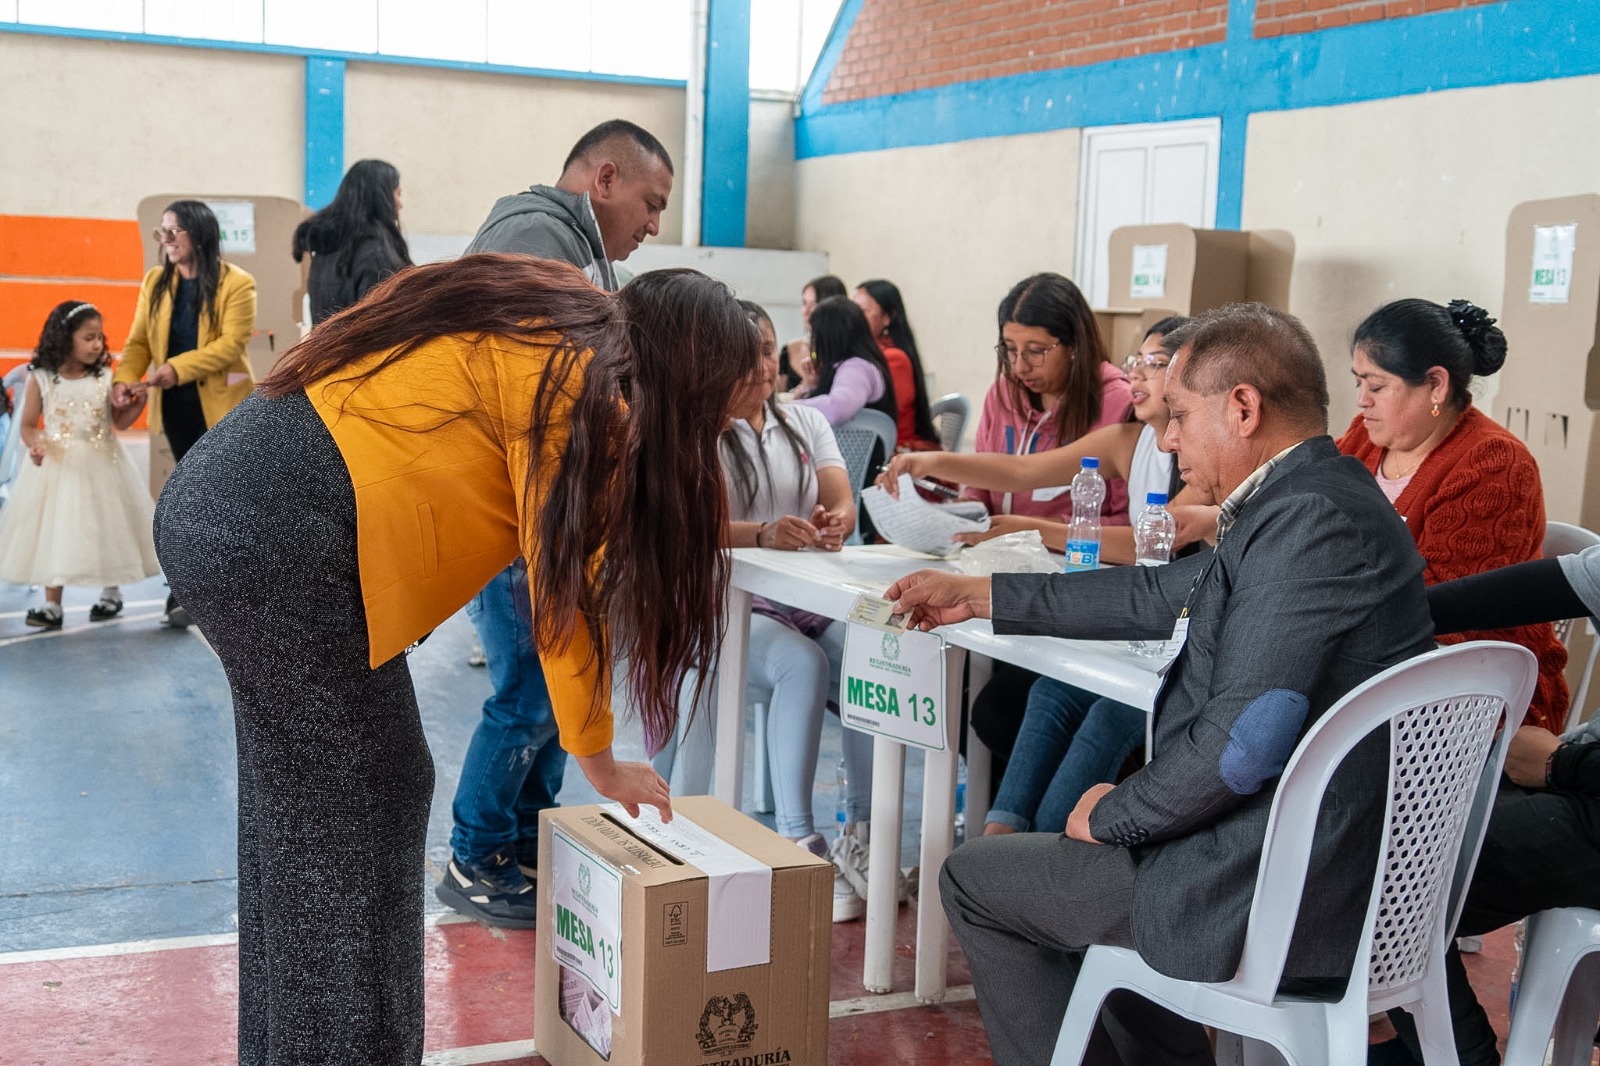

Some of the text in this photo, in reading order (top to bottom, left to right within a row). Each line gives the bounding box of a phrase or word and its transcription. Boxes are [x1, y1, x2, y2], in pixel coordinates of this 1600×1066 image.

[1534, 268, 1555, 286] MESA
[847, 675, 937, 727] MESA 13
[556, 903, 596, 960] MESA
[599, 938, 614, 979] 13
